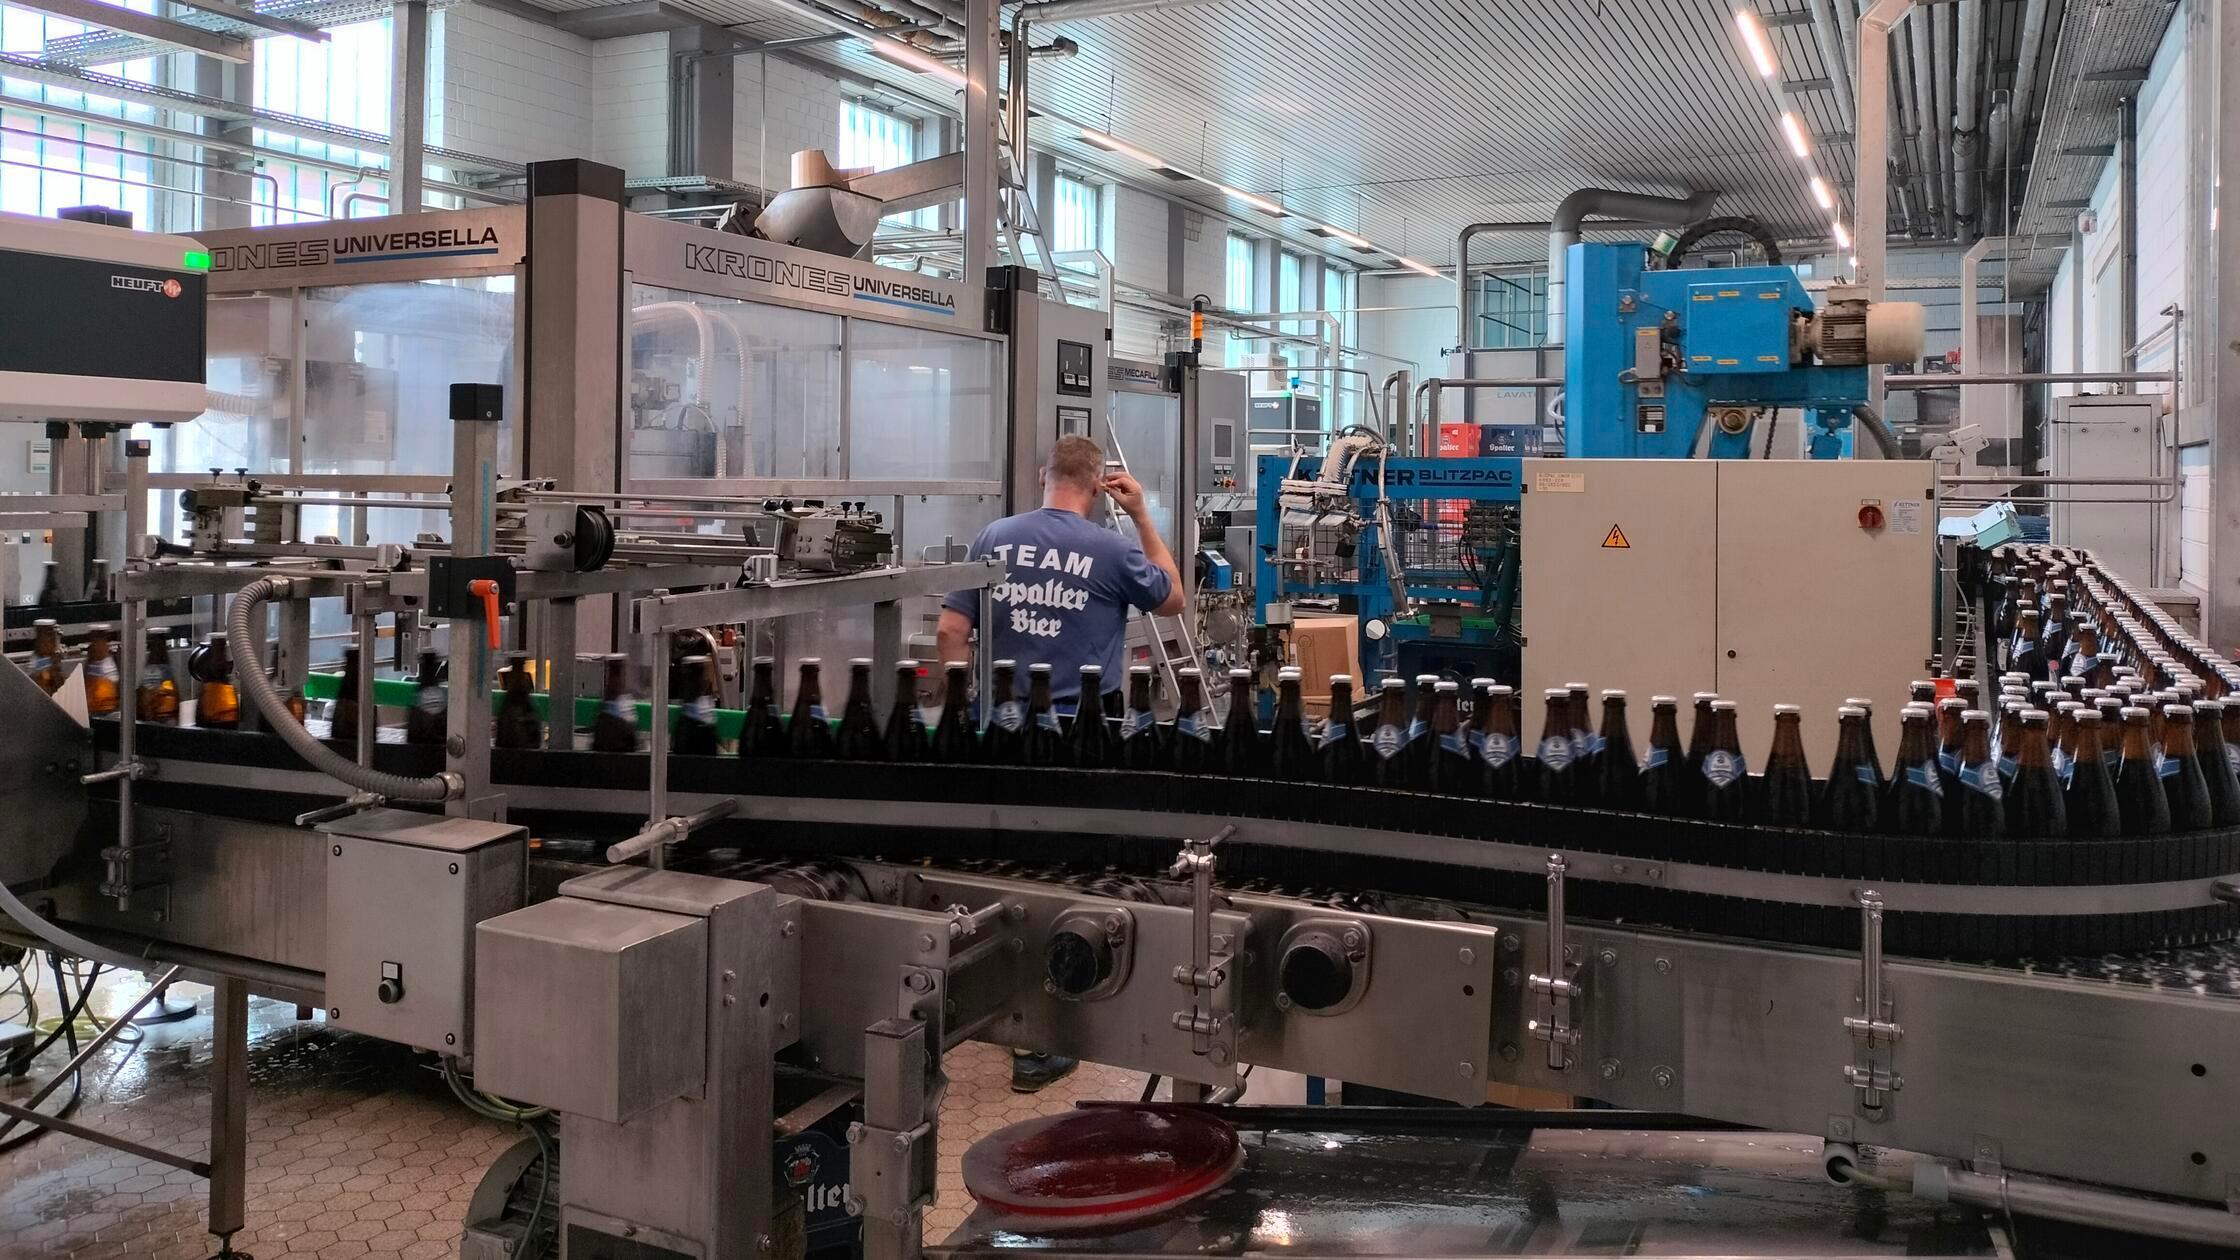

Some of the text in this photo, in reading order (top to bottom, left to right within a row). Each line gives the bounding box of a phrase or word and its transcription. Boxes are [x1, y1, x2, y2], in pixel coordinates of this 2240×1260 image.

[208, 227, 499, 272] ONES UNIVERSELLA
[111, 275, 164, 293] HEUFT
[685, 243, 956, 309] KRONES UNIVERSELLA
[1496, 391, 1536, 399] LAVAT
[1440, 443, 1460, 452] palter
[1419, 469, 1513, 482] BLITZPAC
[993, 544, 1094, 579] TEAM
[992, 573, 1090, 611] Spalter
[1010, 608, 1063, 638] Bier
